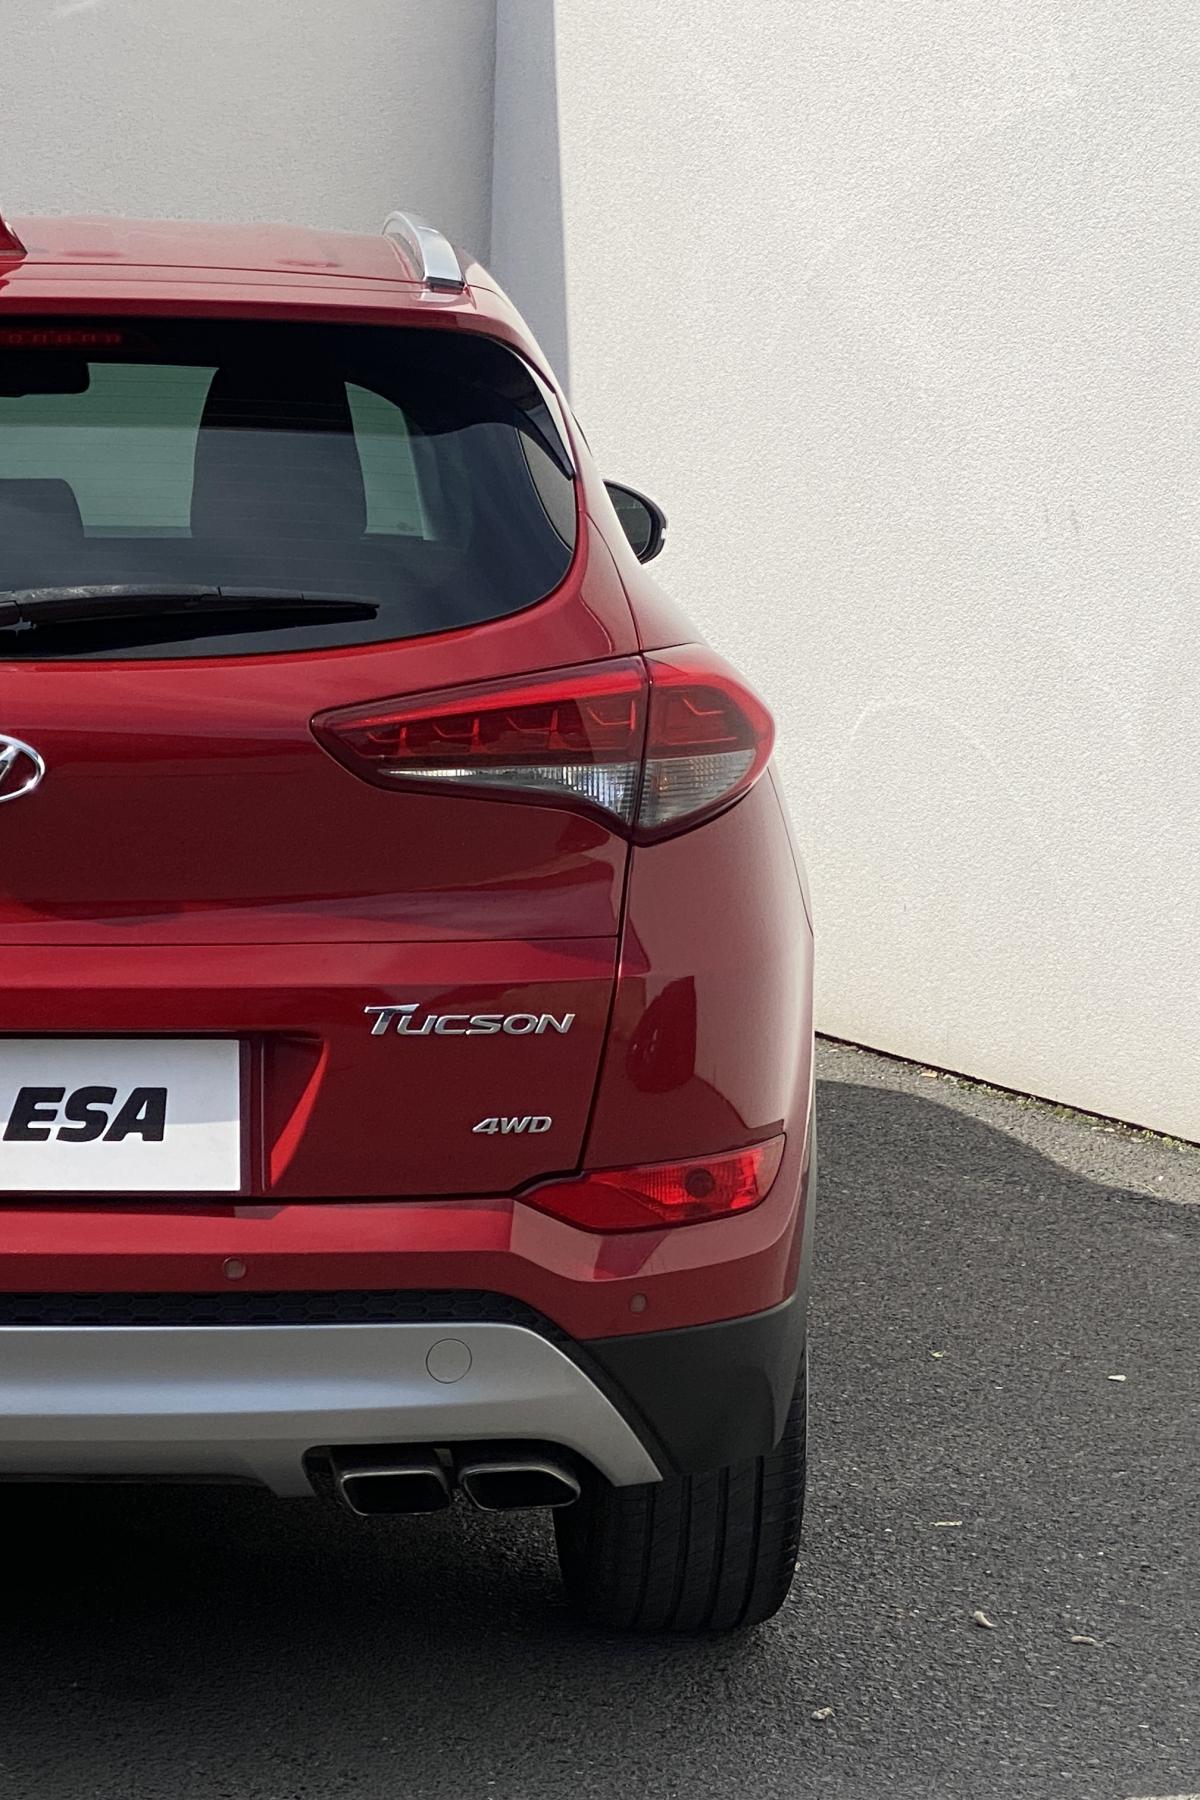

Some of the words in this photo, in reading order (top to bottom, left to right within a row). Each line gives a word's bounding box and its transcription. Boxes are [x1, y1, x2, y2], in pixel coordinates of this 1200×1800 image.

[364, 1003, 576, 1036] TUCSON
[3, 1086, 168, 1143] ESA
[471, 1116, 552, 1135] 4WD
